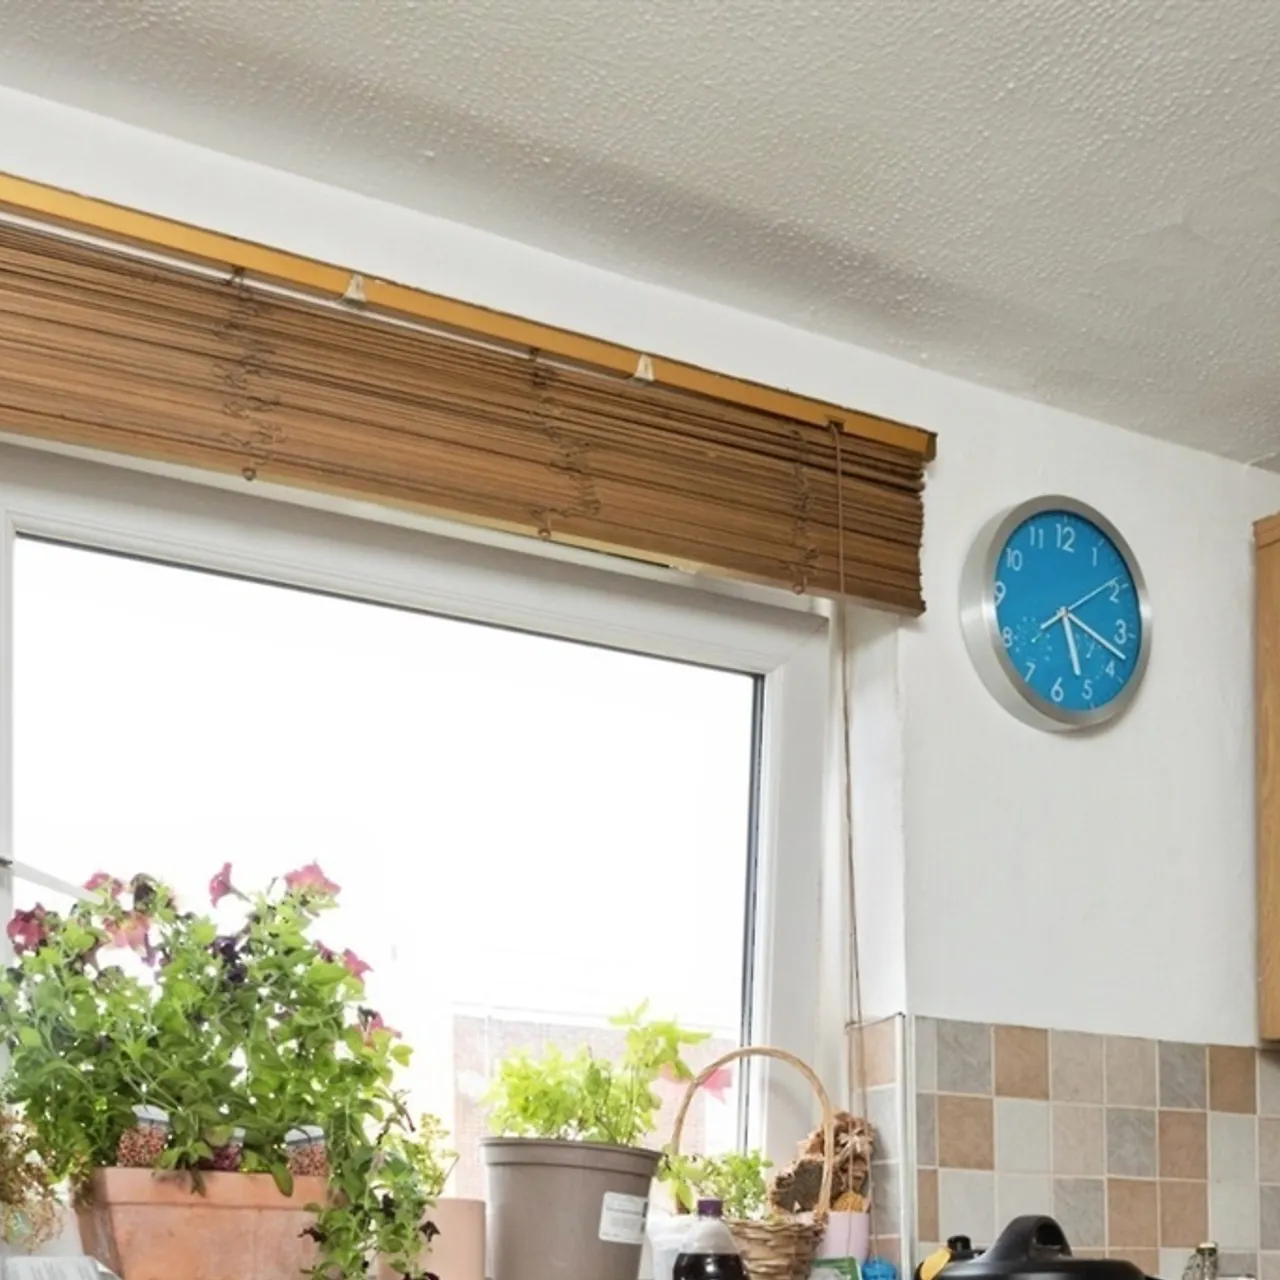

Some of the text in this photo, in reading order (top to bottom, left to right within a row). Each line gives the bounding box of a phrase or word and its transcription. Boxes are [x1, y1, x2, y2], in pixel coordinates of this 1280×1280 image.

[1029, 526, 1044, 549] 11
[1056, 524, 1075, 553] 12
[1006, 548, 1022, 571] 10
[1091, 547, 1097, 567] 1
[995, 581, 1007, 606] 9
[1108, 582, 1120, 604] 2
[1003, 627, 1013, 648] 8
[1114, 620, 1127, 645] 3
[1025, 661, 1036, 682] 7
[1105, 660, 1115, 678] 4
[1051, 677, 1064, 702] 6
[1081, 679, 1093, 700] 5
